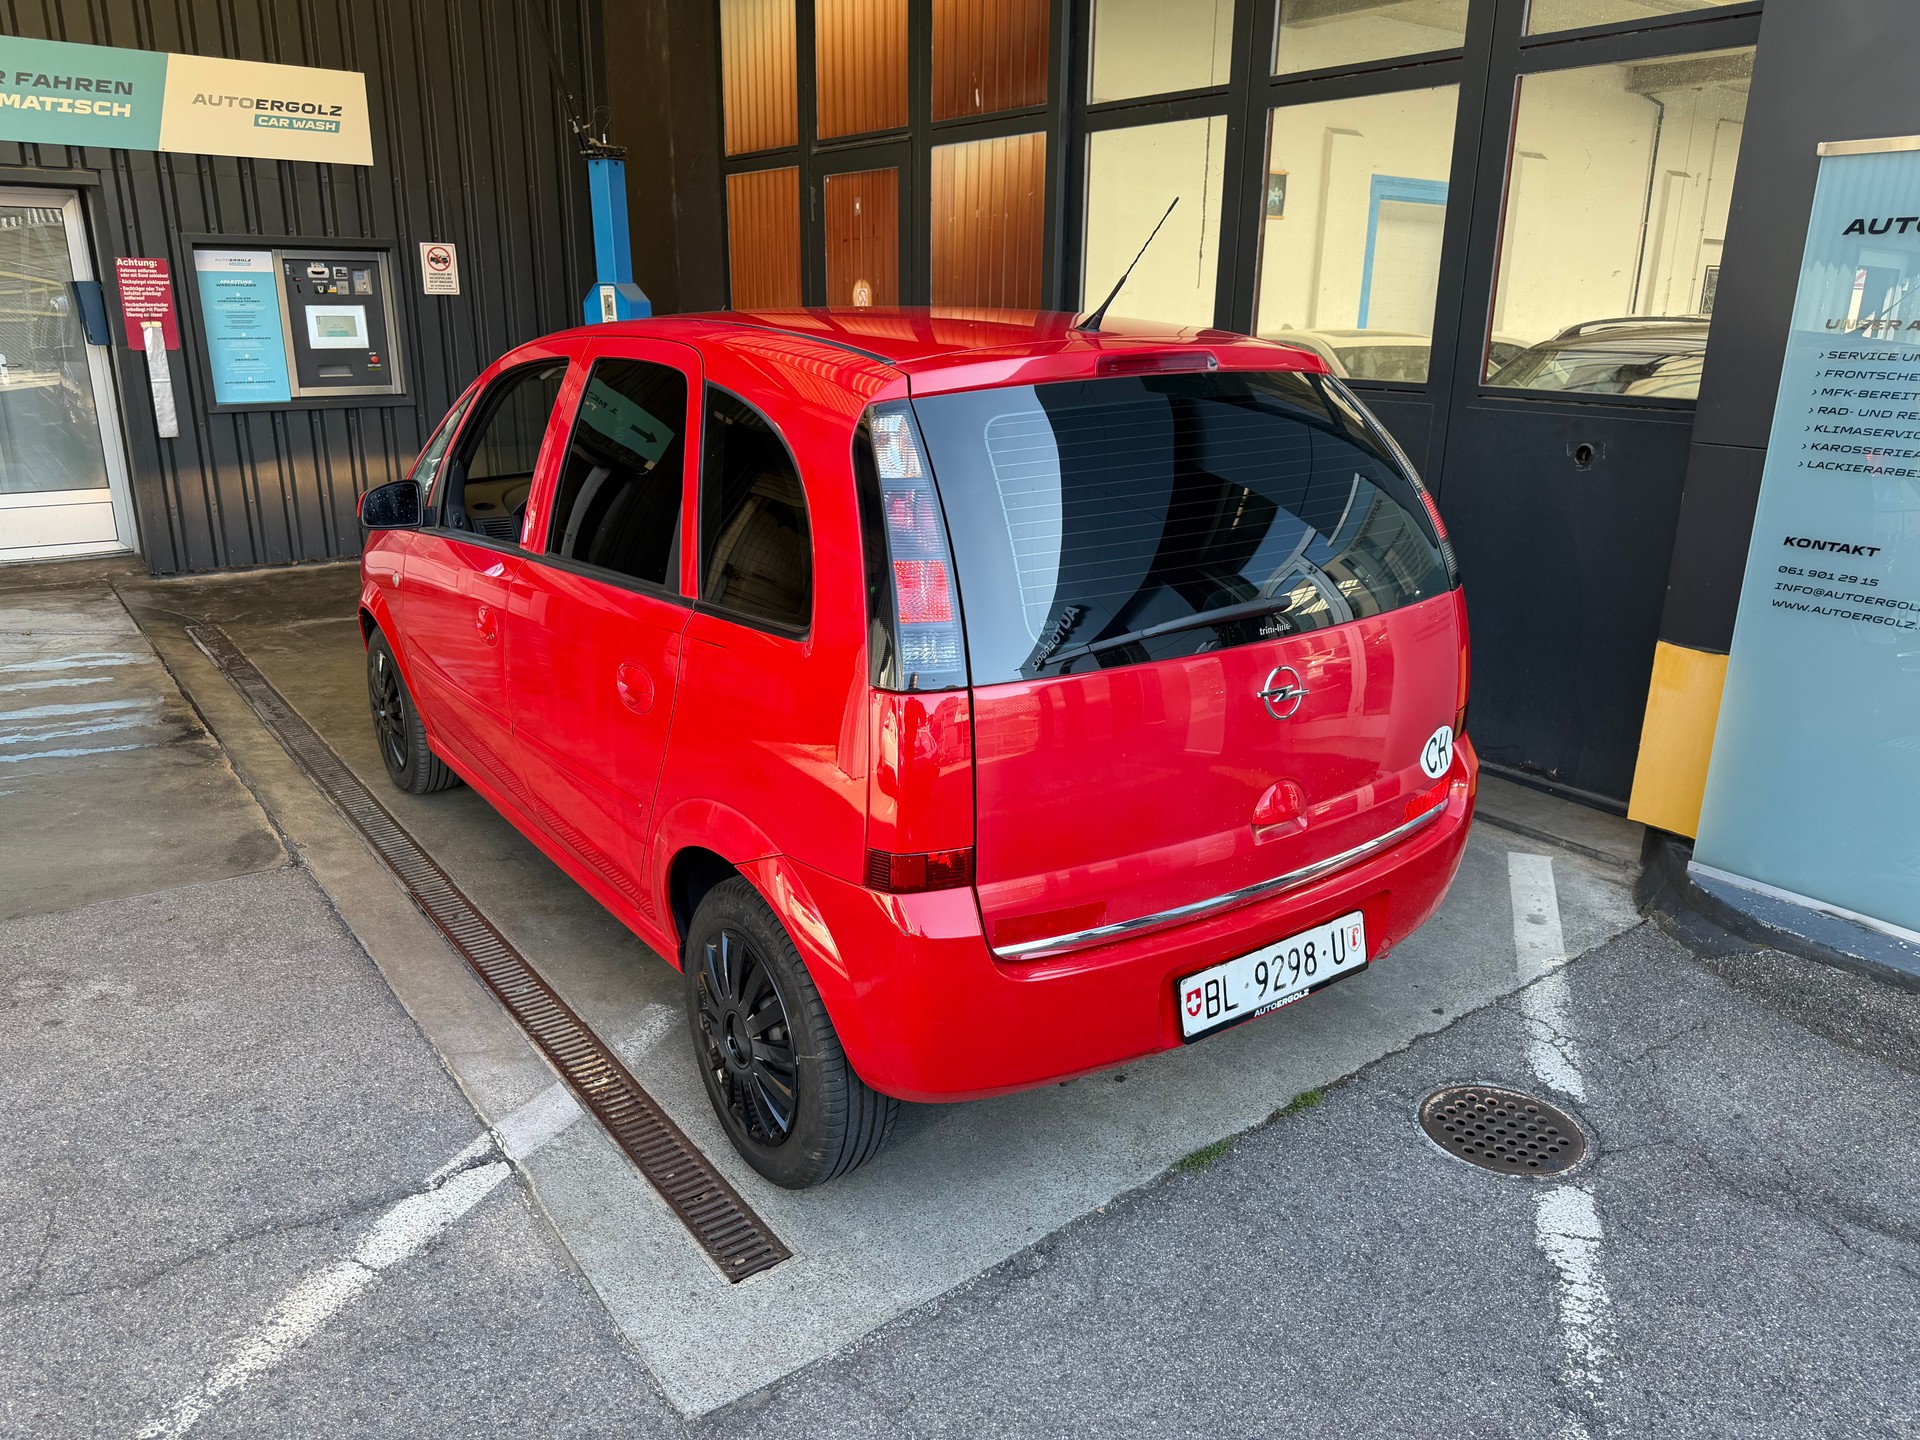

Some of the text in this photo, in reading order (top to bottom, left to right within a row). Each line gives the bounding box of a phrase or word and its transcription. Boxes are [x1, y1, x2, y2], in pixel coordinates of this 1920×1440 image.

[15, 71, 133, 96] FAHREN
[0, 92, 131, 118] MATISCH
[192, 93, 343, 117] AUTOERGOLZ
[258, 116, 337, 132] CAR WASH
[1842, 217, 1920, 235] AUT
[116, 258, 157, 269] Achtung:
[1825, 319, 1903, 331] UNSER
[1827, 351, 1900, 361] SERVICE
[1824, 369, 1920, 382] FRONTSCHE
[1820, 388, 1920, 401] MFK-BEREIT
[1817, 406, 1854, 416] RAD-
[1858, 408, 1893, 419] UND
[1783, 536, 1881, 557] KONTAKT
[1778, 565, 1880, 587] 061 901 29 15
[1774, 582, 1920, 612] INFO@AUTOERGOL
[1772, 599, 1920, 630] WWW.AUTOERGOLZ.
[1426, 730, 1449, 774] CH
[1254, 988, 1310, 1018] AUTOERGOLZ
